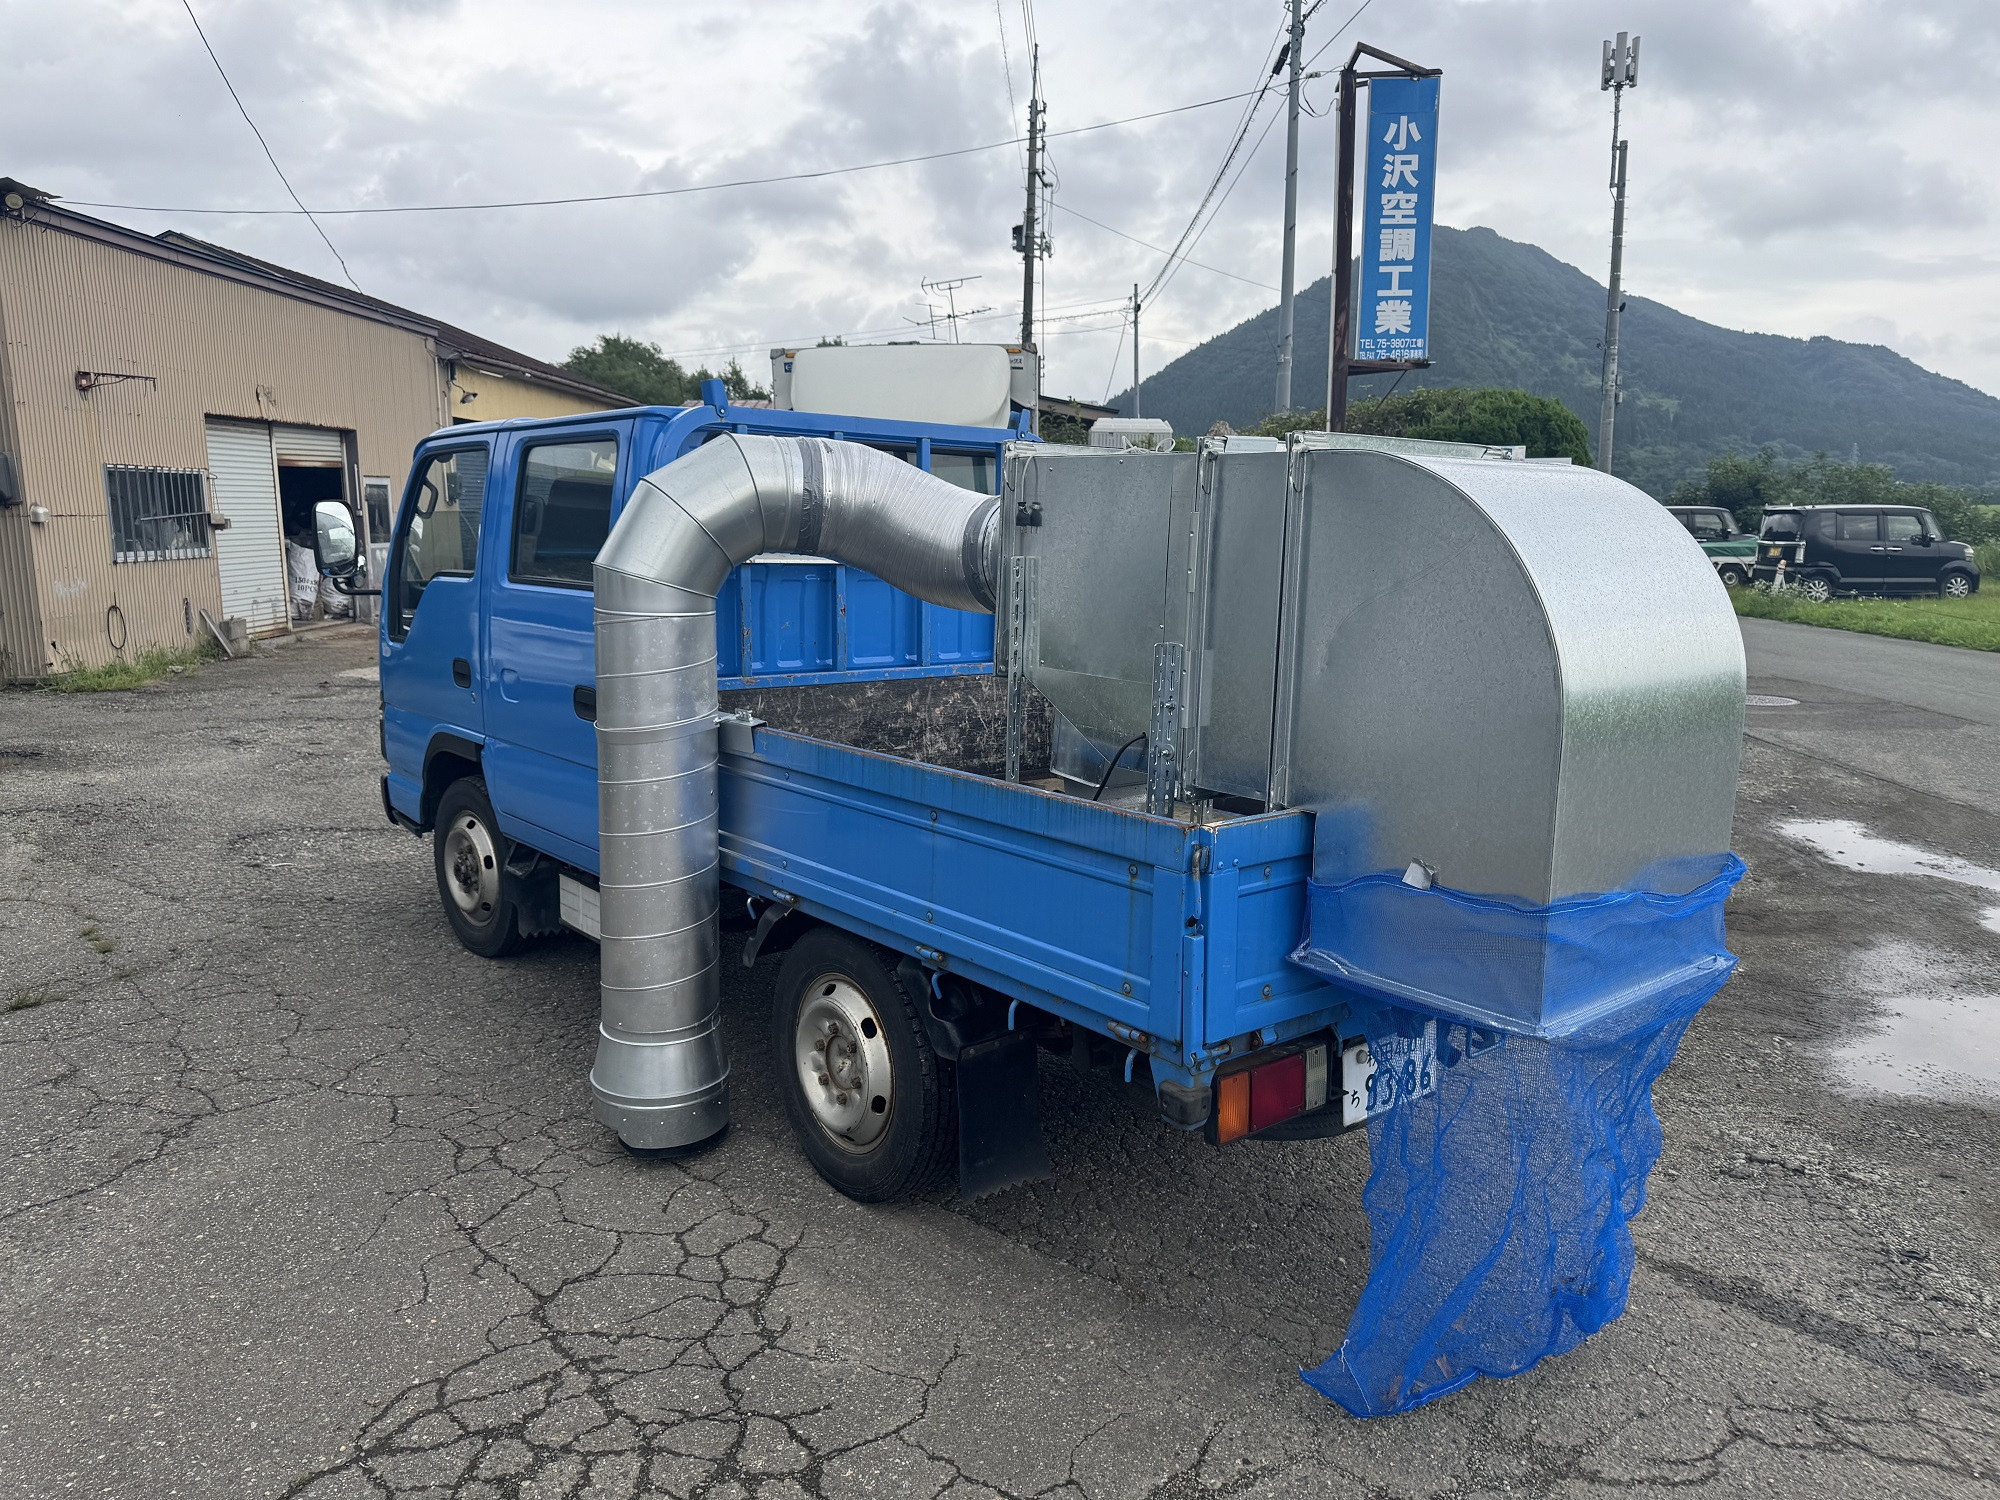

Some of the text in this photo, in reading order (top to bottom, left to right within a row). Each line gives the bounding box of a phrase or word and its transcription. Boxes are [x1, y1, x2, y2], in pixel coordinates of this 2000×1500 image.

[1374, 115, 1422, 335] 小沢空調工業
[1360, 339, 1375, 348] TEL
[1351, 1053, 1432, 1111] ち 9386
